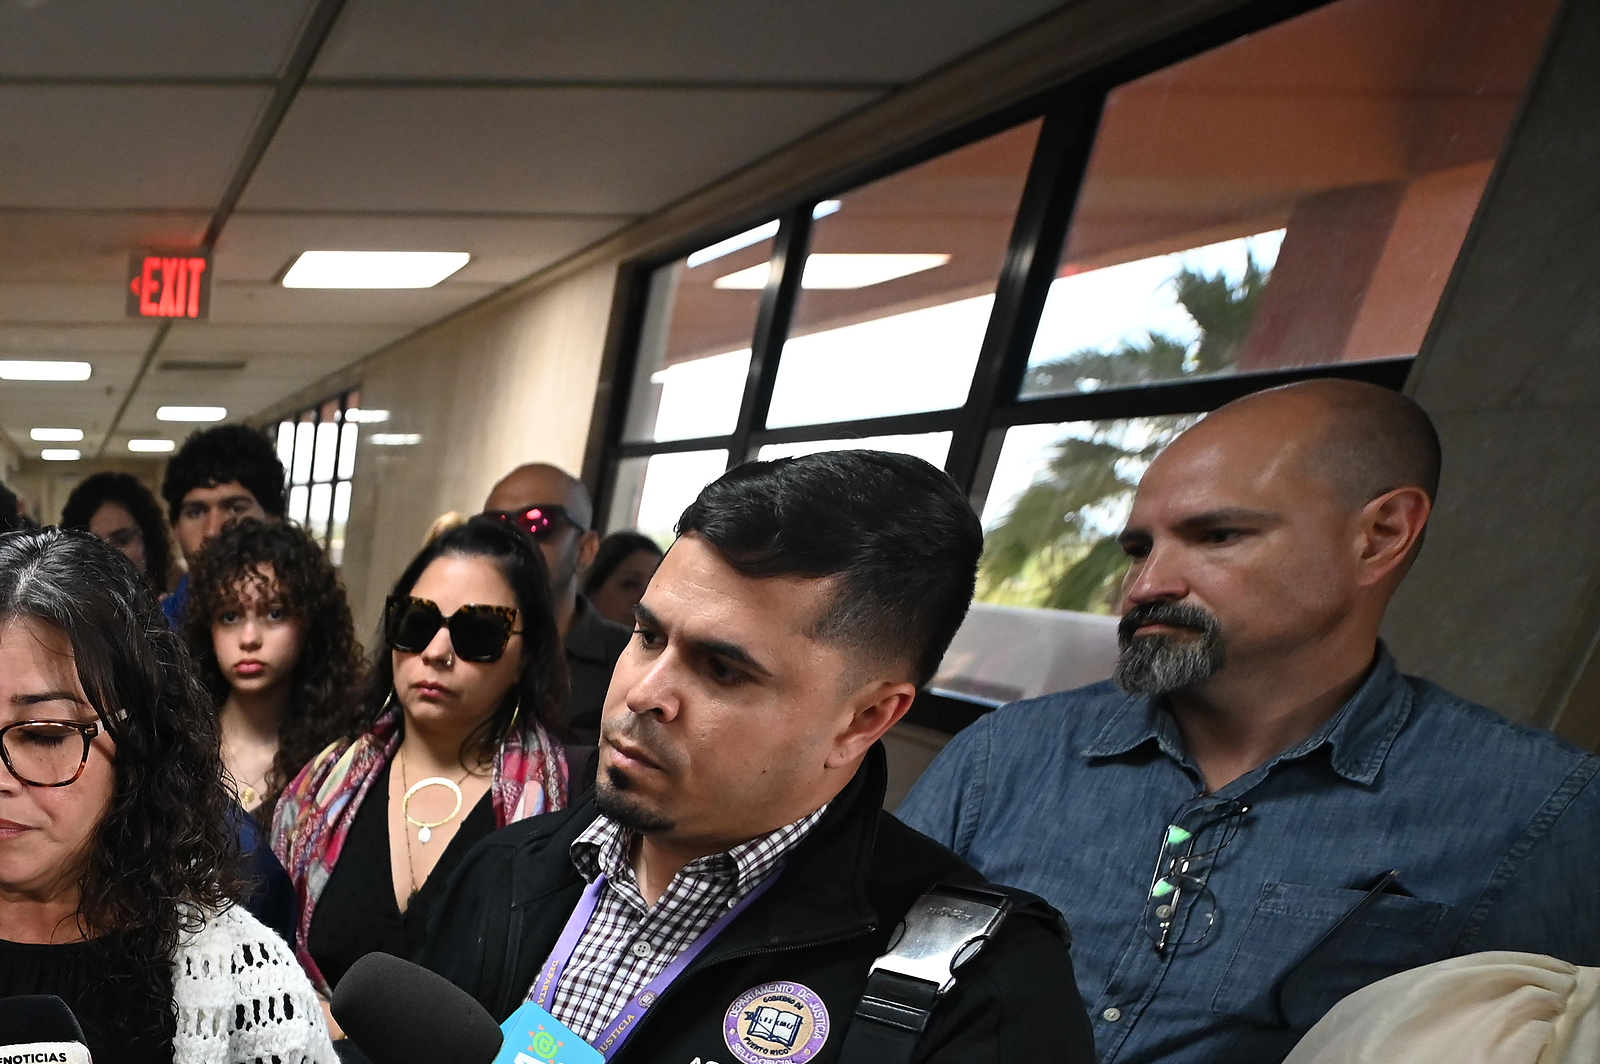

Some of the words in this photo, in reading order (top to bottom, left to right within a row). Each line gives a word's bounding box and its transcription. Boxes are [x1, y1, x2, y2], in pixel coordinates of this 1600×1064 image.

[537, 960, 559, 1009] DEPARTA
[730, 984, 795, 1018] DEPARTAMENTO
[796, 988, 813, 1002] DE
[809, 1001, 826, 1039] JUSTICIA
[732, 1042, 759, 1064] SELLO
